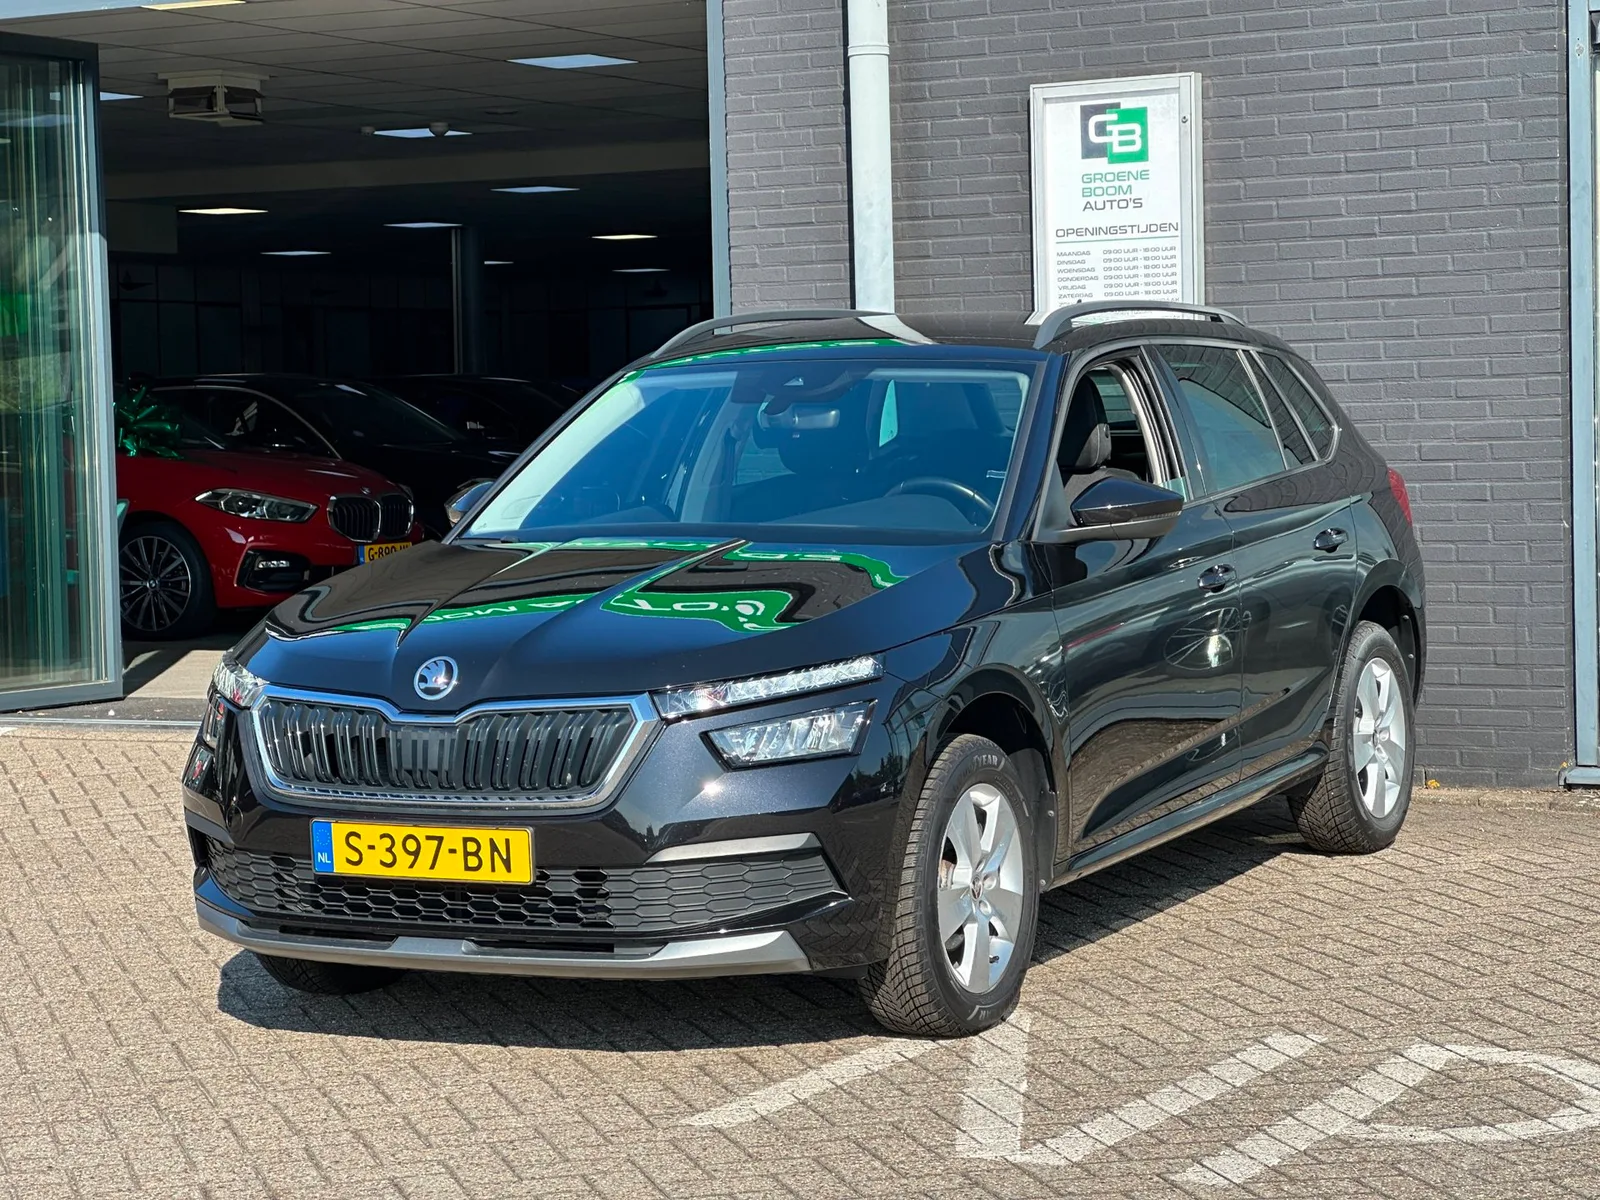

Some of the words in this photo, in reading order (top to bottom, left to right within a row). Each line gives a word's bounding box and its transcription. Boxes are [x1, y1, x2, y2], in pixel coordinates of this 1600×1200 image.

[1081, 169, 1150, 184] GROENE
[1081, 184, 1133, 198] BOOM
[1082, 198, 1143, 212] AUTO'S
[1055, 222, 1179, 238] OPENINGSTIJDEN
[317, 851, 332, 864] NL
[344, 831, 512, 873] S-397-BN
